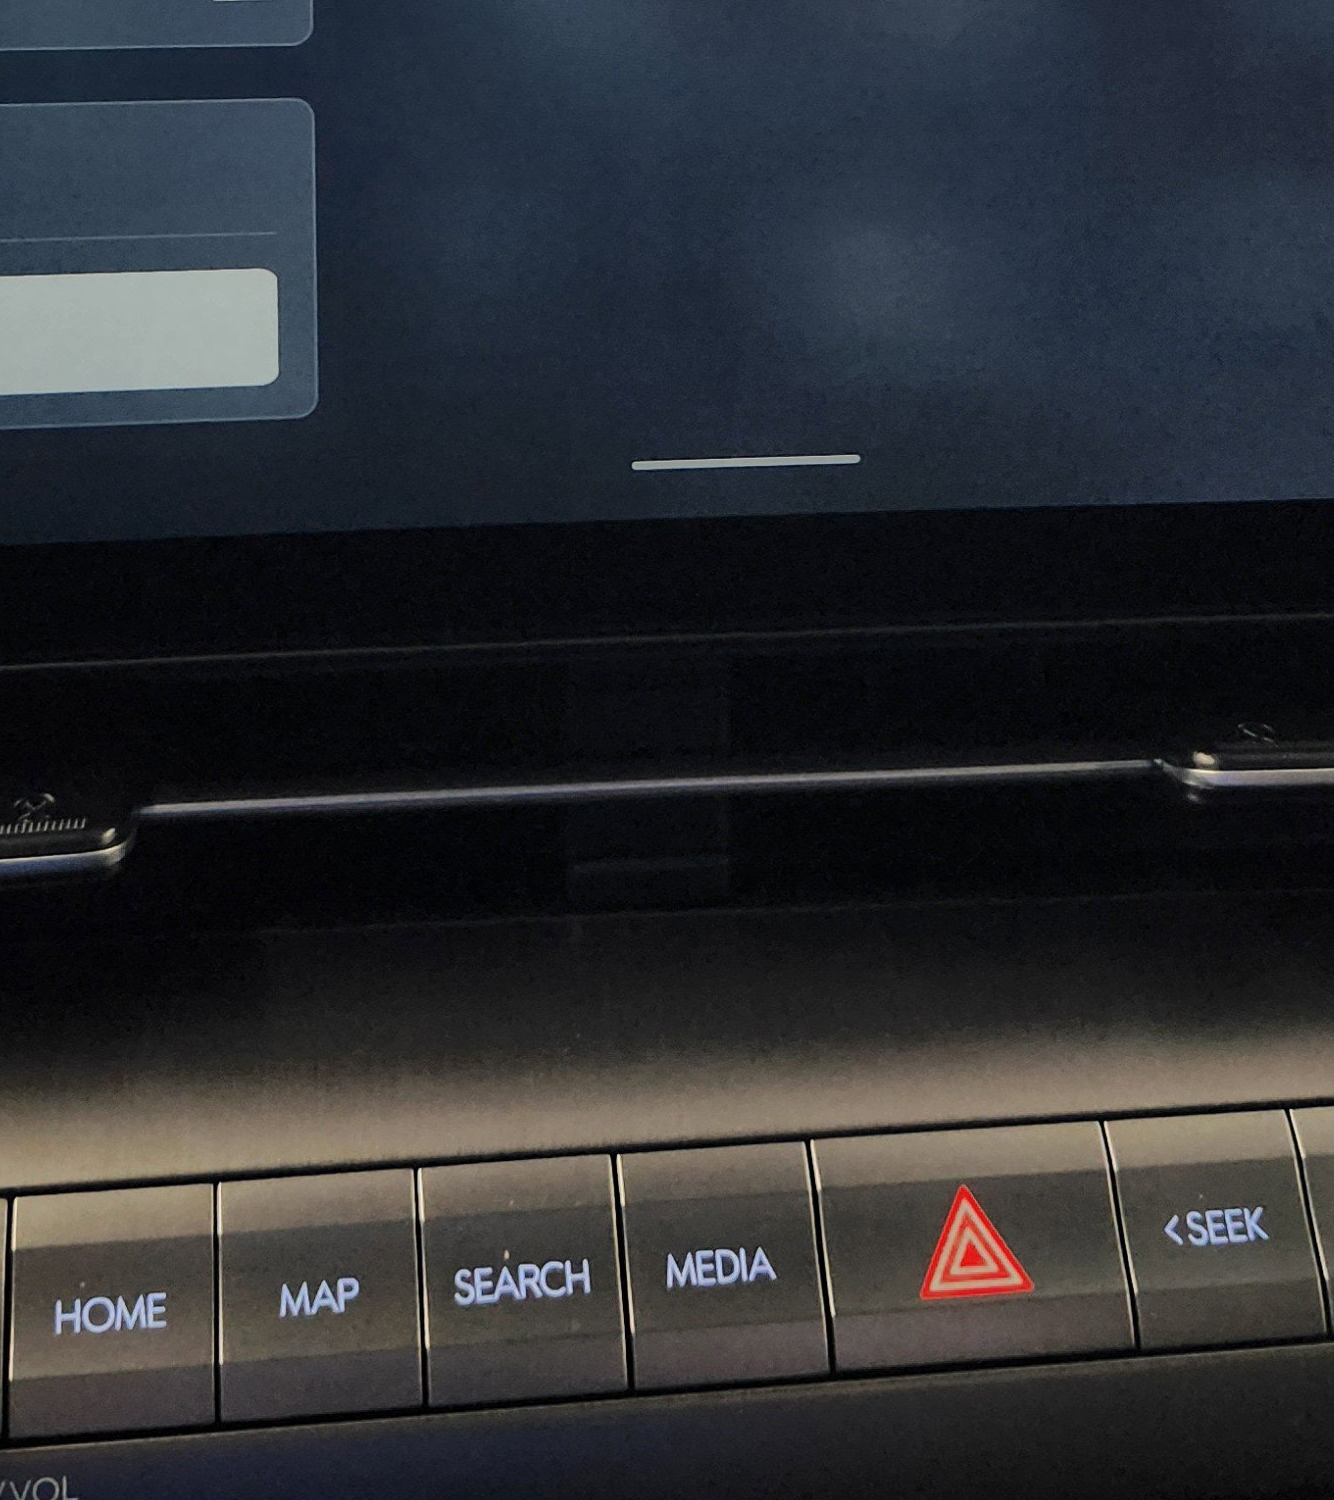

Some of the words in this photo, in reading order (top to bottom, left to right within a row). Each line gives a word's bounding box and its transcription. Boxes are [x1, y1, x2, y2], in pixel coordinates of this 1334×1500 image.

[453, 1258, 592, 1306] SEARCH
[666, 1246, 779, 1290] MEDIA
[53, 1292, 168, 1336] HOME
[278, 1277, 361, 1319] MAP
